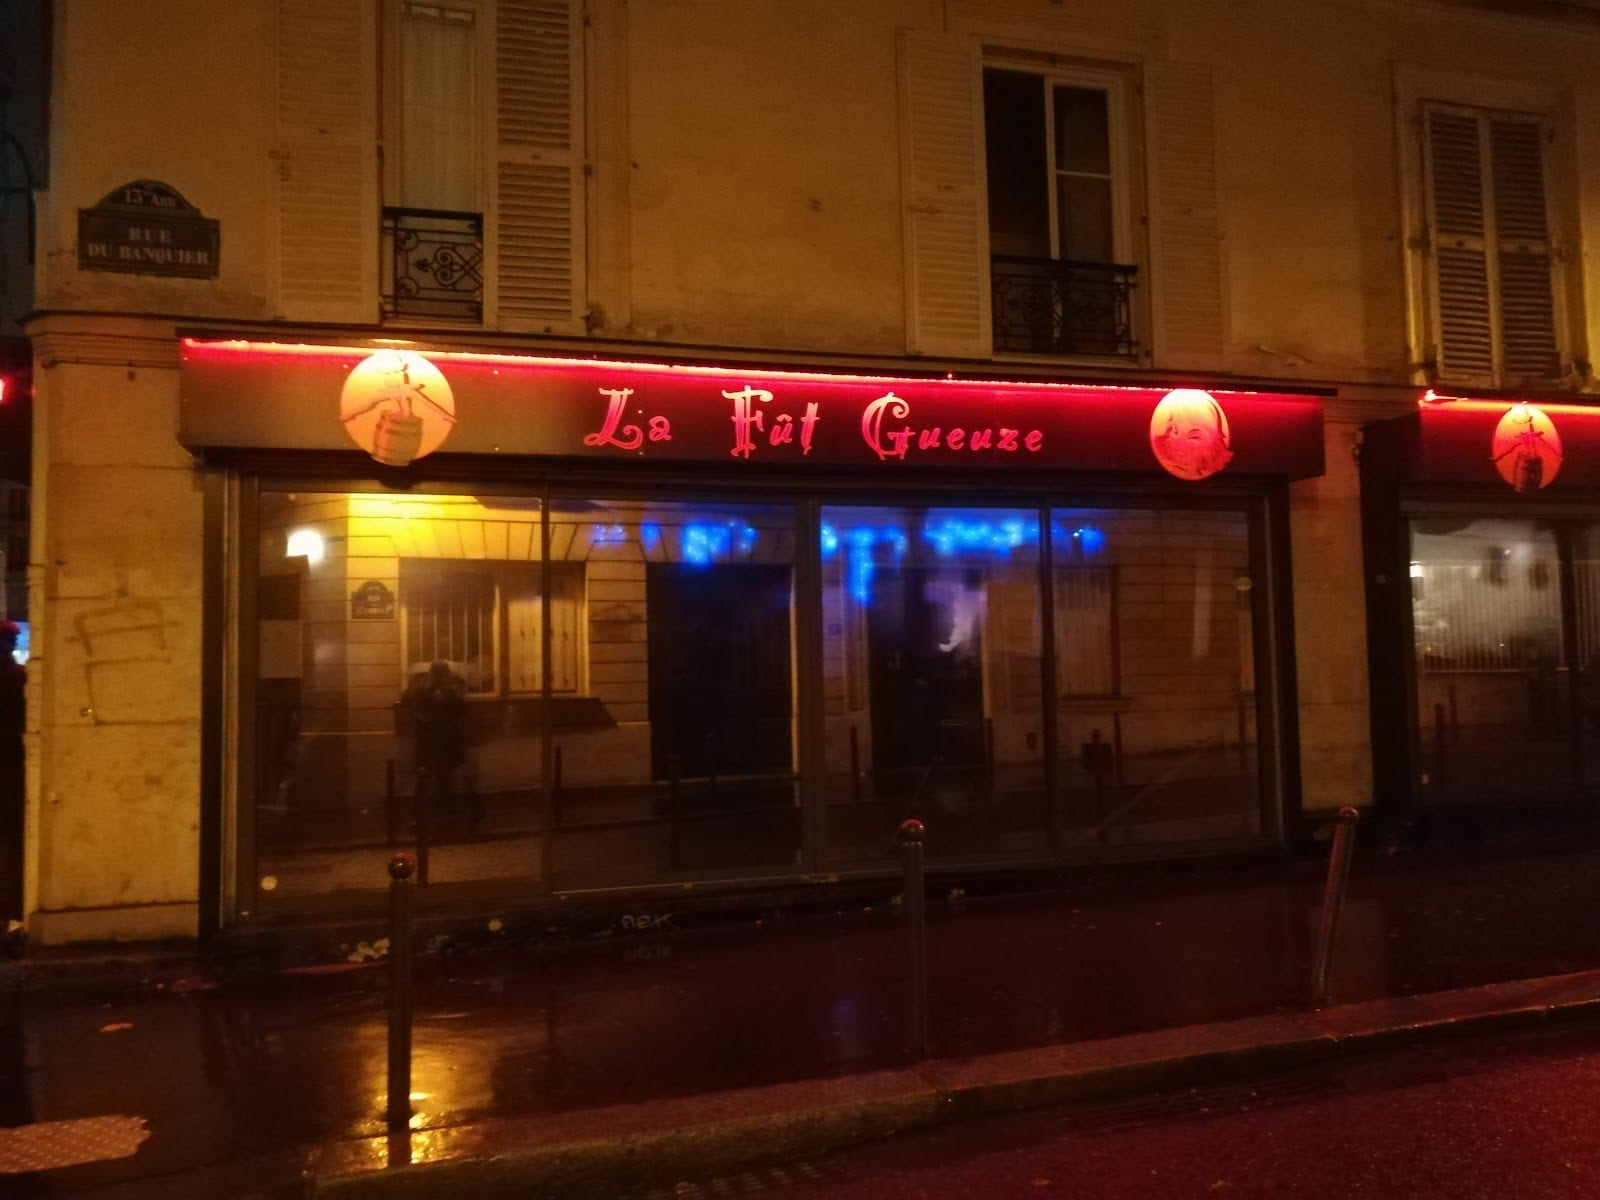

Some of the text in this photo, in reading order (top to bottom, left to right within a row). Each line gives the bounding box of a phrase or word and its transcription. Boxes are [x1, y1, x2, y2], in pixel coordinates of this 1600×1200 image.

[128, 227, 173, 243] RUE
[87, 242, 209, 265] DU BANQUIER
[583, 385, 1043, 461] La Fût Gueuze
